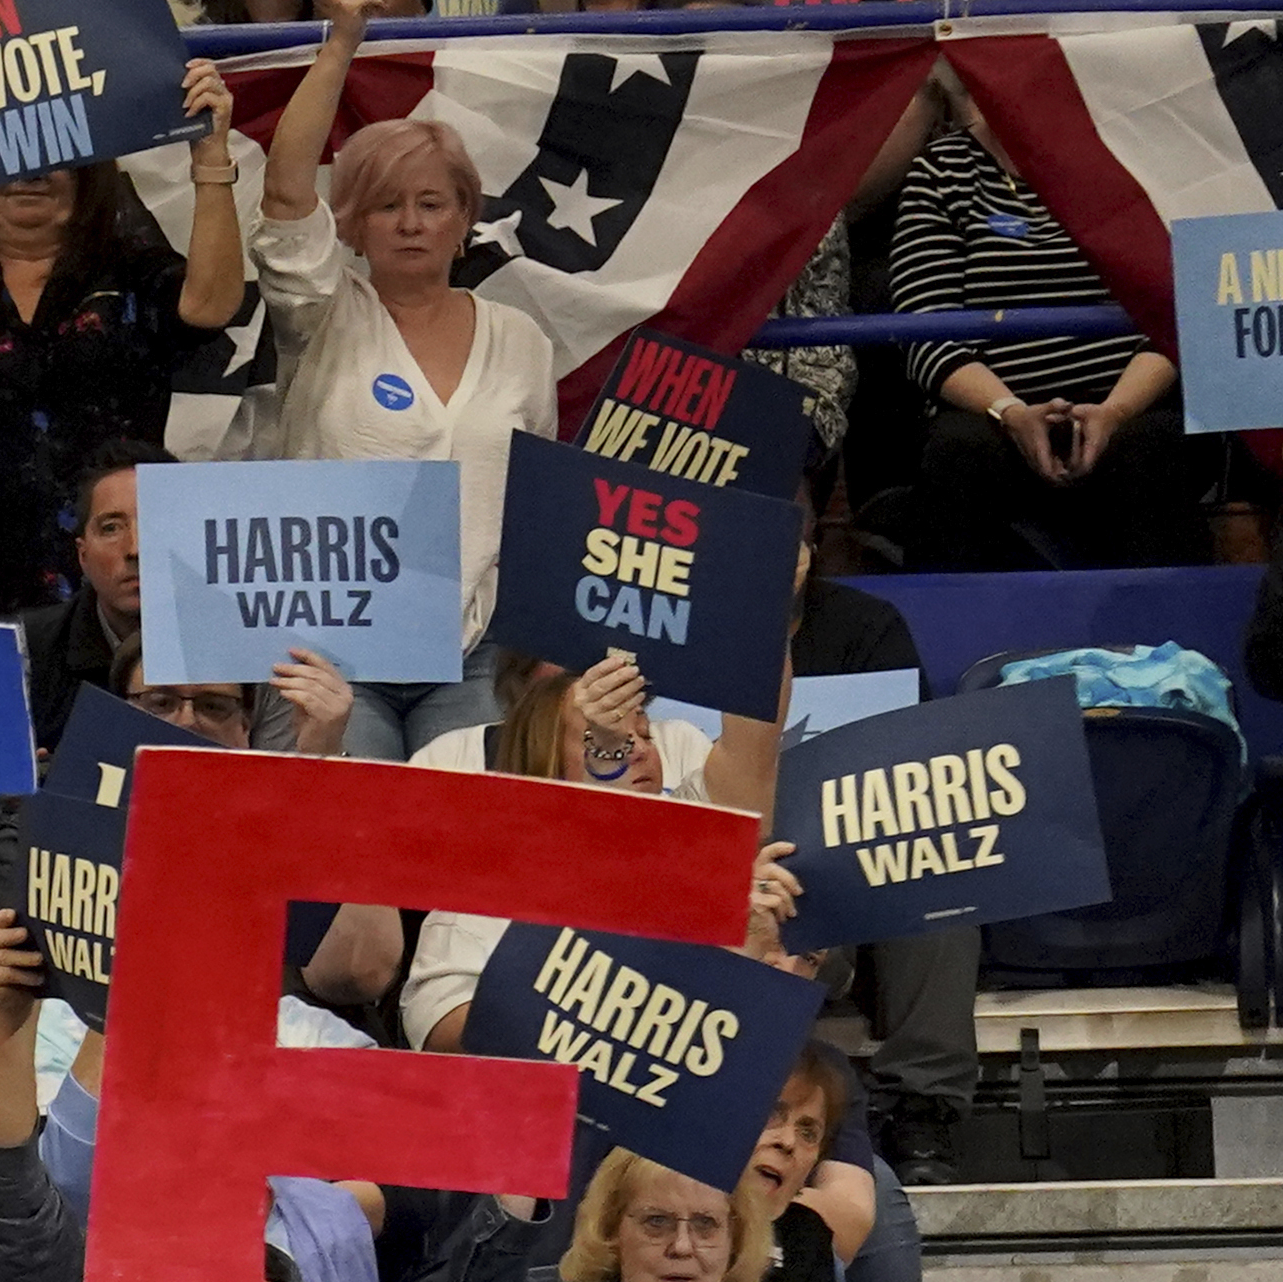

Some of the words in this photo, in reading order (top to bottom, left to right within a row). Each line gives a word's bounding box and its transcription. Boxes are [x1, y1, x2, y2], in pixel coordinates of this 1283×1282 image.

[1217, 252, 1243, 306] A
[615, 337, 738, 430] WHEN
[593, 477, 700, 547] YES
[199, 516, 400, 584] HARRIS
[581, 528, 696, 597] SHE
[237, 590, 373, 629] WALZ
[574, 575, 691, 646] CAN
[823, 743, 1028, 849] HARRIS
[856, 825, 1004, 888] WALZ
[45, 928, 116, 986] WAL
[533, 926, 740, 1077] HARRIS
[537, 1008, 680, 1109] WALZ
